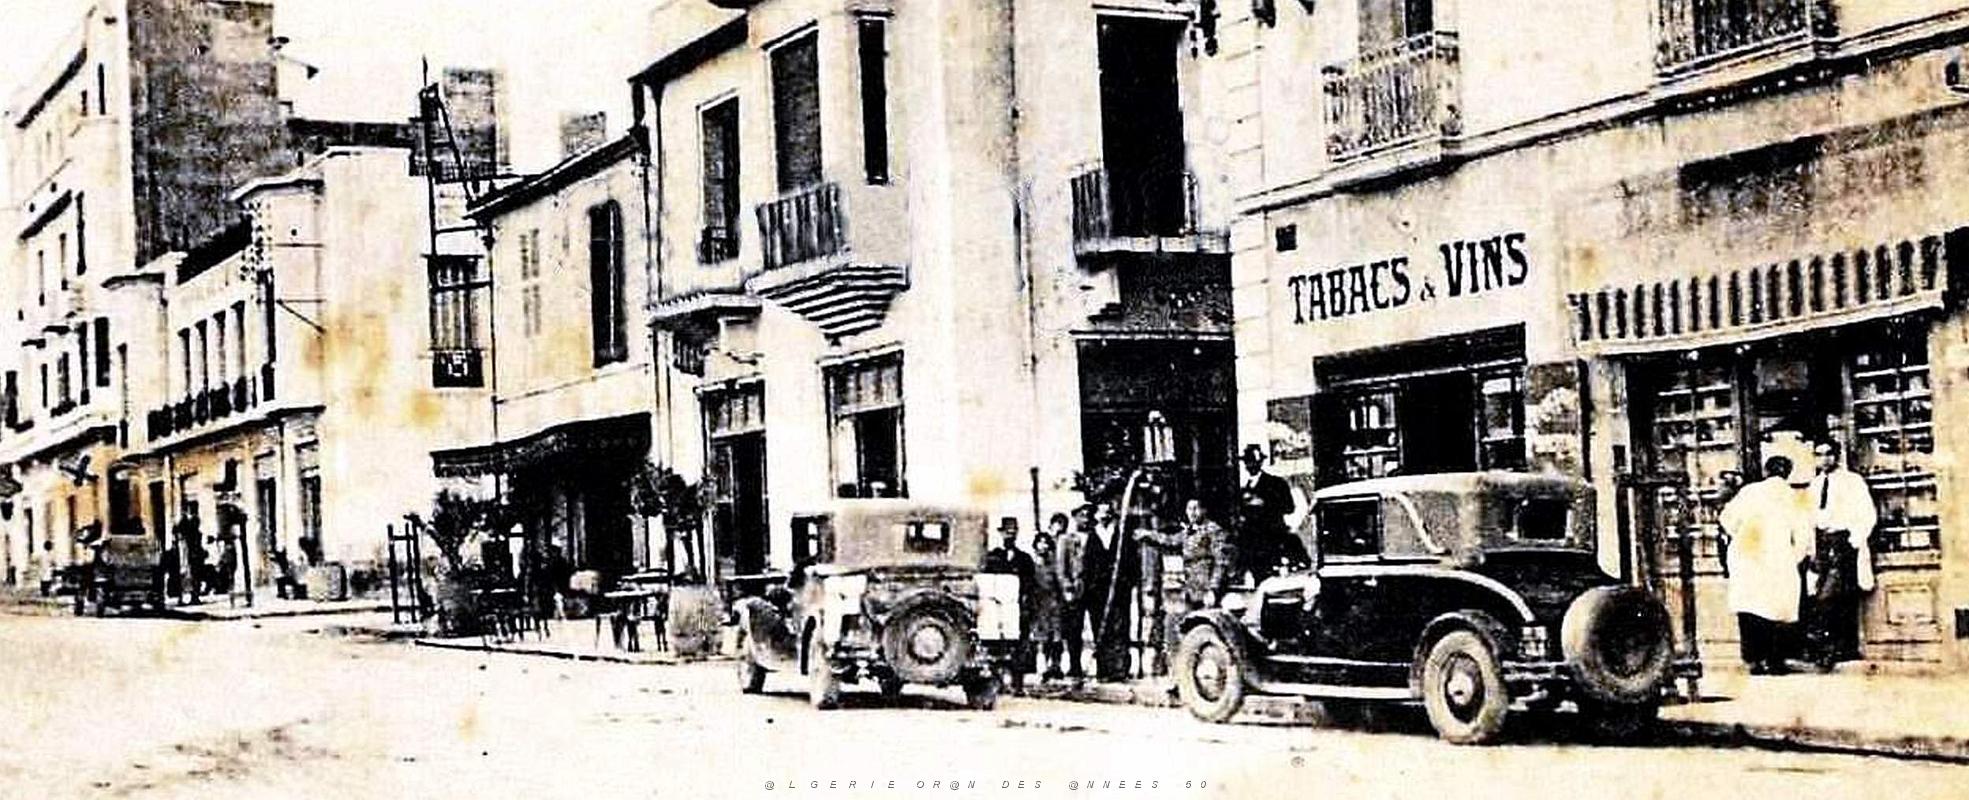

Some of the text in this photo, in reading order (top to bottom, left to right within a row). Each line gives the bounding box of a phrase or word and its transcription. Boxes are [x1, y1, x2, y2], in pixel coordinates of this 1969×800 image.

[1288, 232, 1529, 324] TABACS & VINS
